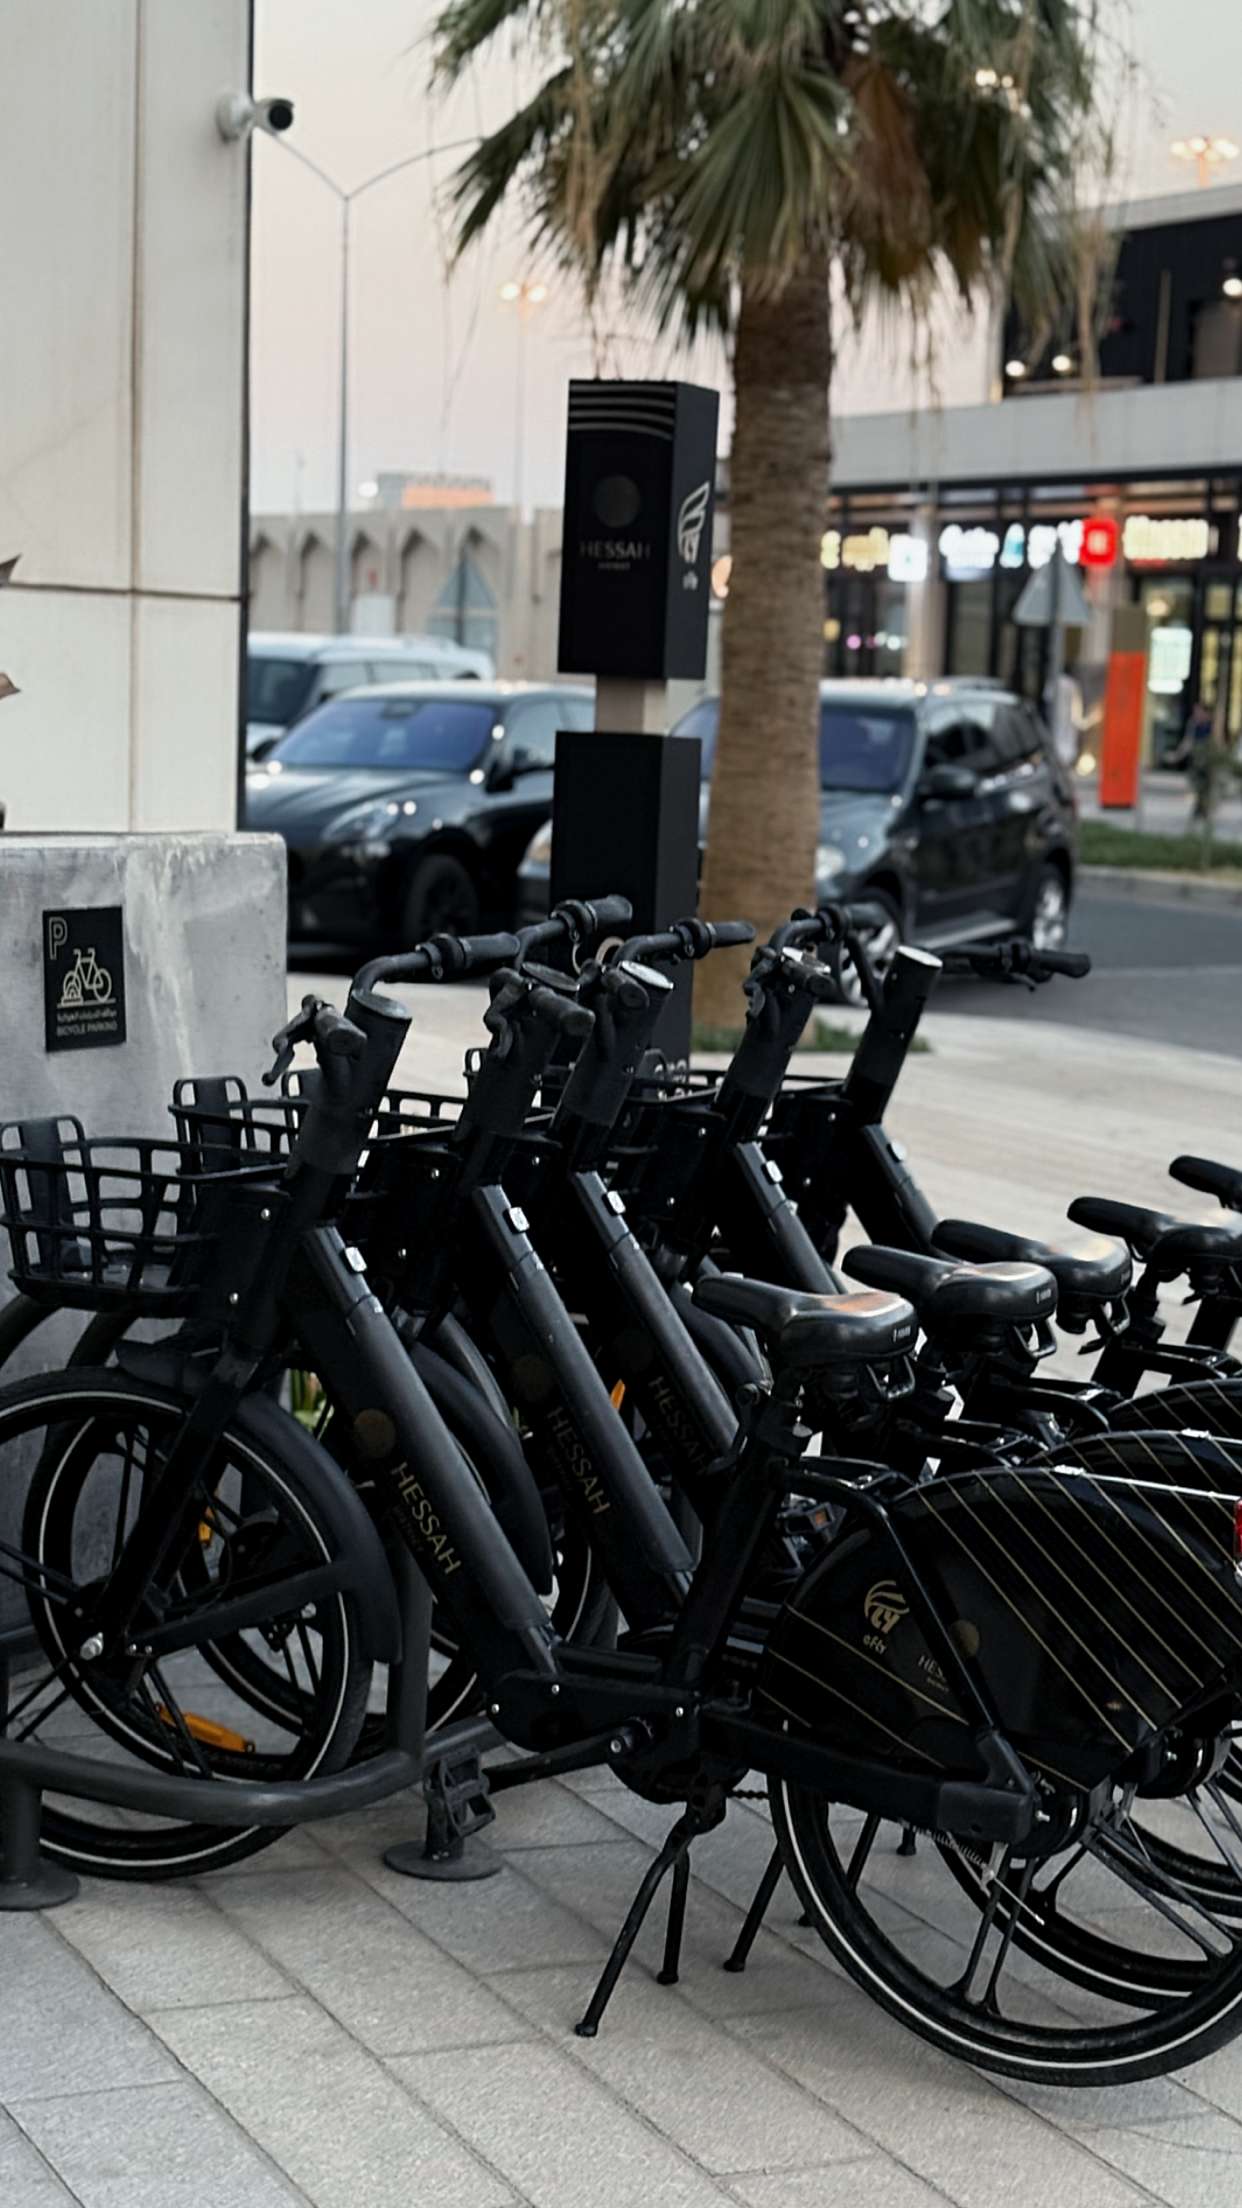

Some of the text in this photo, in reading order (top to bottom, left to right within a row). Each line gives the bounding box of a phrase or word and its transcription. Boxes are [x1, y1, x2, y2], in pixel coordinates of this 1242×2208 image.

[579, 540, 651, 559] HESSAH
[49, 917, 68, 960] P
[545, 1405, 612, 1515] HESSAH
[390, 1461, 463, 1574] HESSAH
